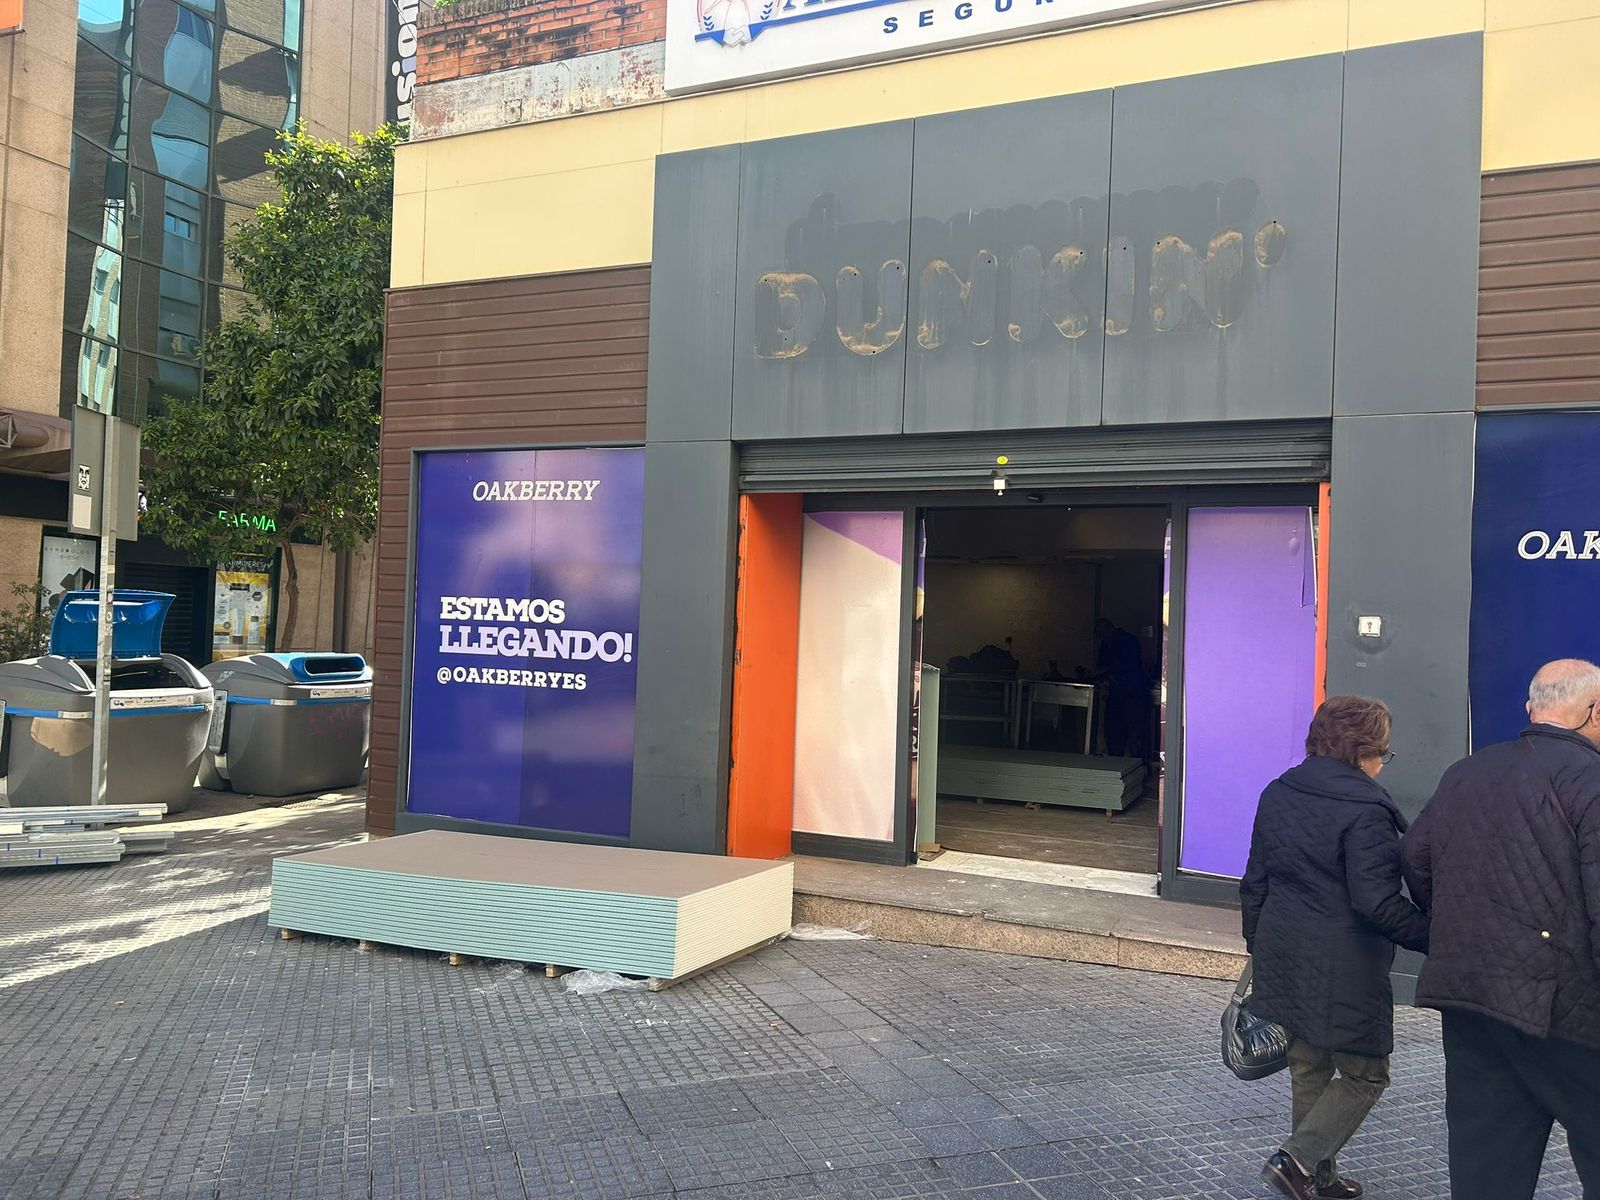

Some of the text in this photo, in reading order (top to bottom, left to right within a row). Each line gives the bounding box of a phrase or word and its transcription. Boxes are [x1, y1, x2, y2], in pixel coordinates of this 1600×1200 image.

[882, 0, 1055, 34] SEGU
[472, 480, 600, 501] OAKBERRY
[1517, 530, 1600, 560] OAK
[439, 596, 566, 624] ESTAMOS
[439, 624, 633, 663] LLEGANDO!
[436, 667, 587, 690] @OAKBERRYES
